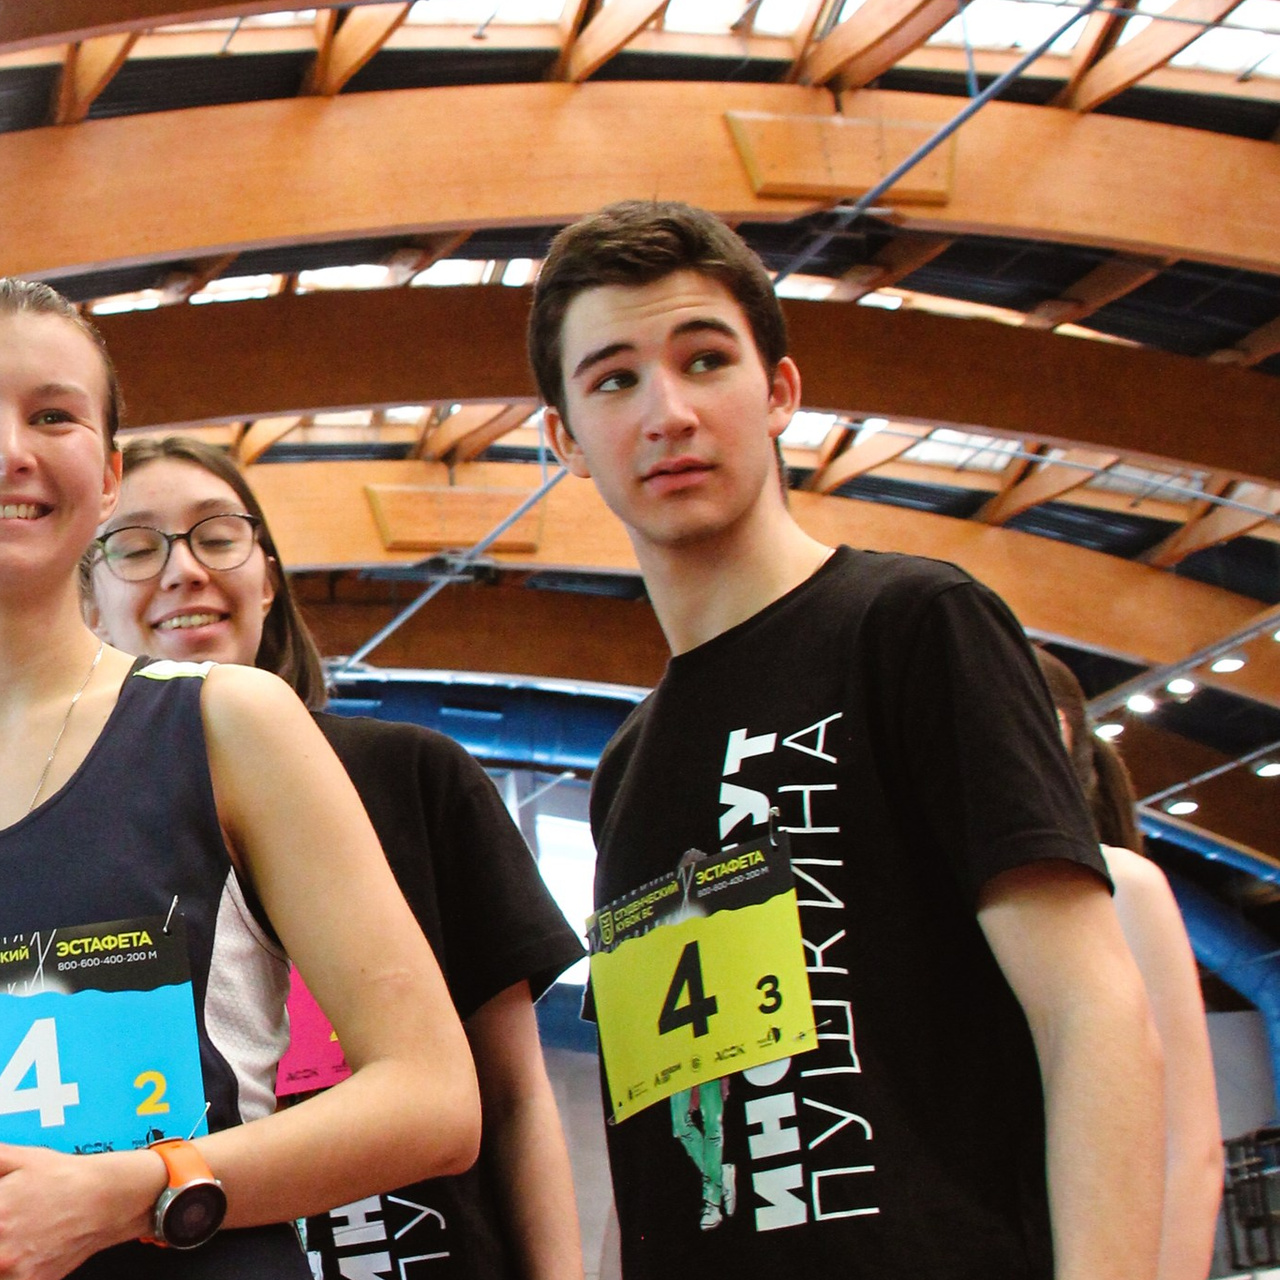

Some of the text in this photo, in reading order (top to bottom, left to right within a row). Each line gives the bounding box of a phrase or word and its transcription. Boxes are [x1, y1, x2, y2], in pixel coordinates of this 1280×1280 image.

[695, 850, 766, 885] ЭСТАФЕТА
[56, 930, 153, 957] ЭСТАФЕТА
[57, 952, 147, 971] 800-600-400-200
[657, 940, 783, 1038] 4 3
[133, 1070, 170, 1116] 2
